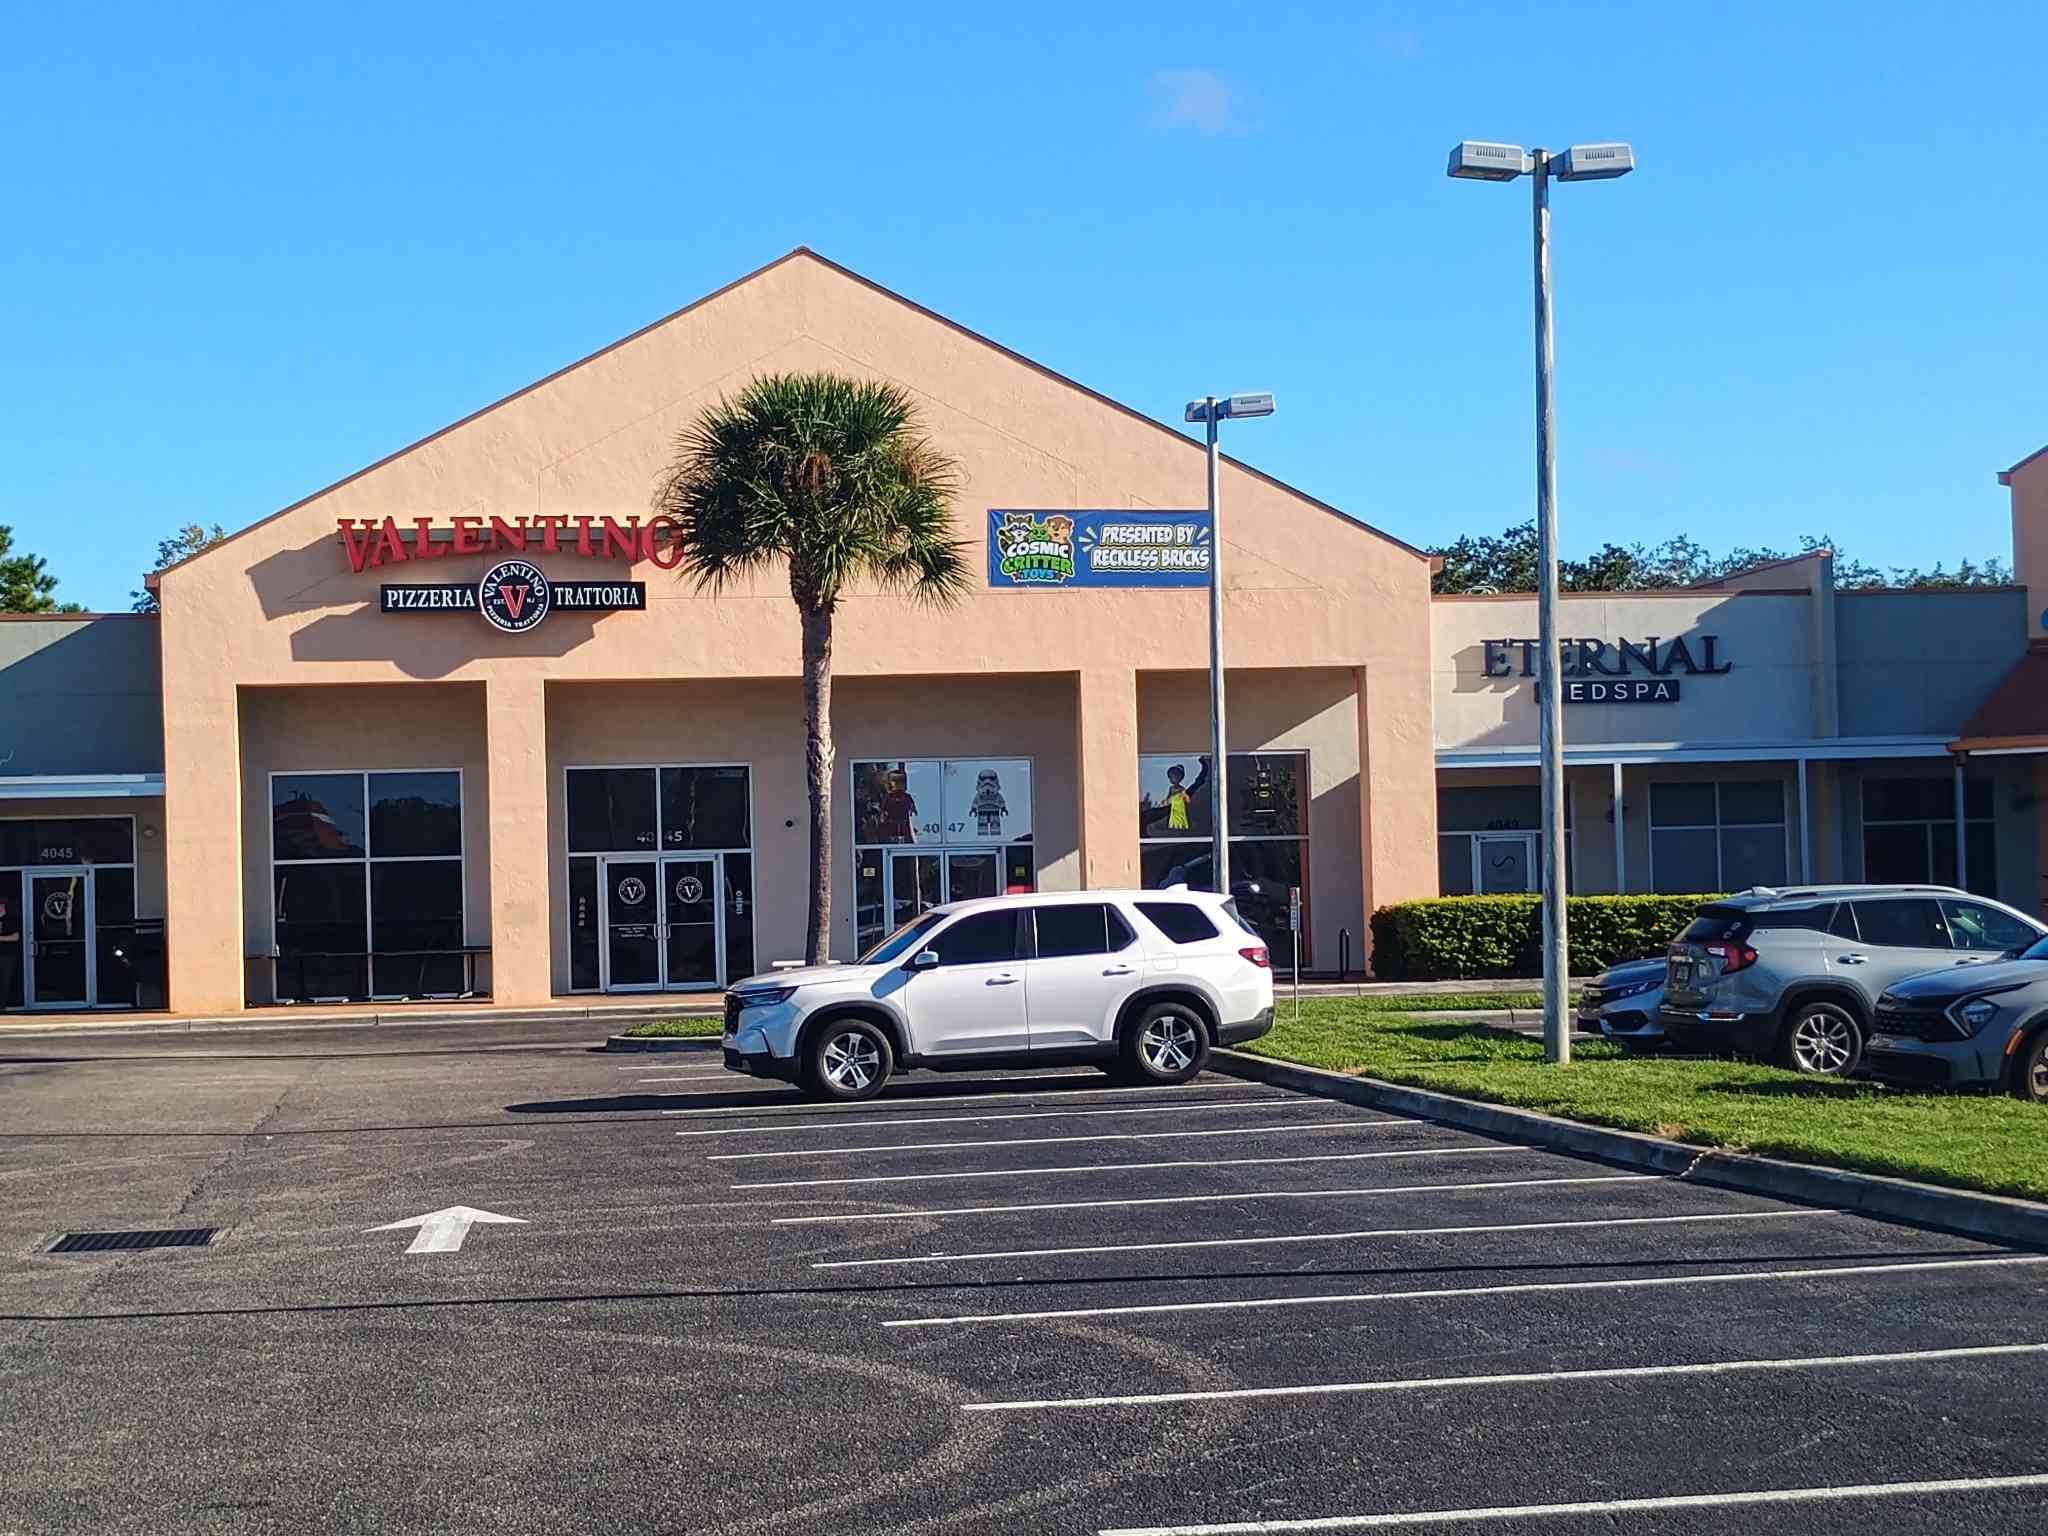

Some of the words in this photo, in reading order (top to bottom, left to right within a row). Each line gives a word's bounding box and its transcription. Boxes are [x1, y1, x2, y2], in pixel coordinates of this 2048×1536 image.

[337, 514, 685, 573] VALENTINO
[1101, 526, 1173, 544] PRESENTED
[1177, 526, 1194, 543] BY
[1006, 541, 1069, 558] COSMIC
[1093, 549, 1158, 567] RECKLESS
[1161, 549, 1209, 567] BRICKS
[1003, 555, 1073, 576] CRITTER
[1023, 569, 1055, 579] TOYS
[484, 564, 545, 598] VALENTINO
[386, 590, 476, 609] PIZZERIA
[499, 585, 530, 619] V
[554, 587, 639, 607] TRATTORIA
[1569, 682, 1671, 701] EDSPA
[41, 847, 73, 858] 4045
